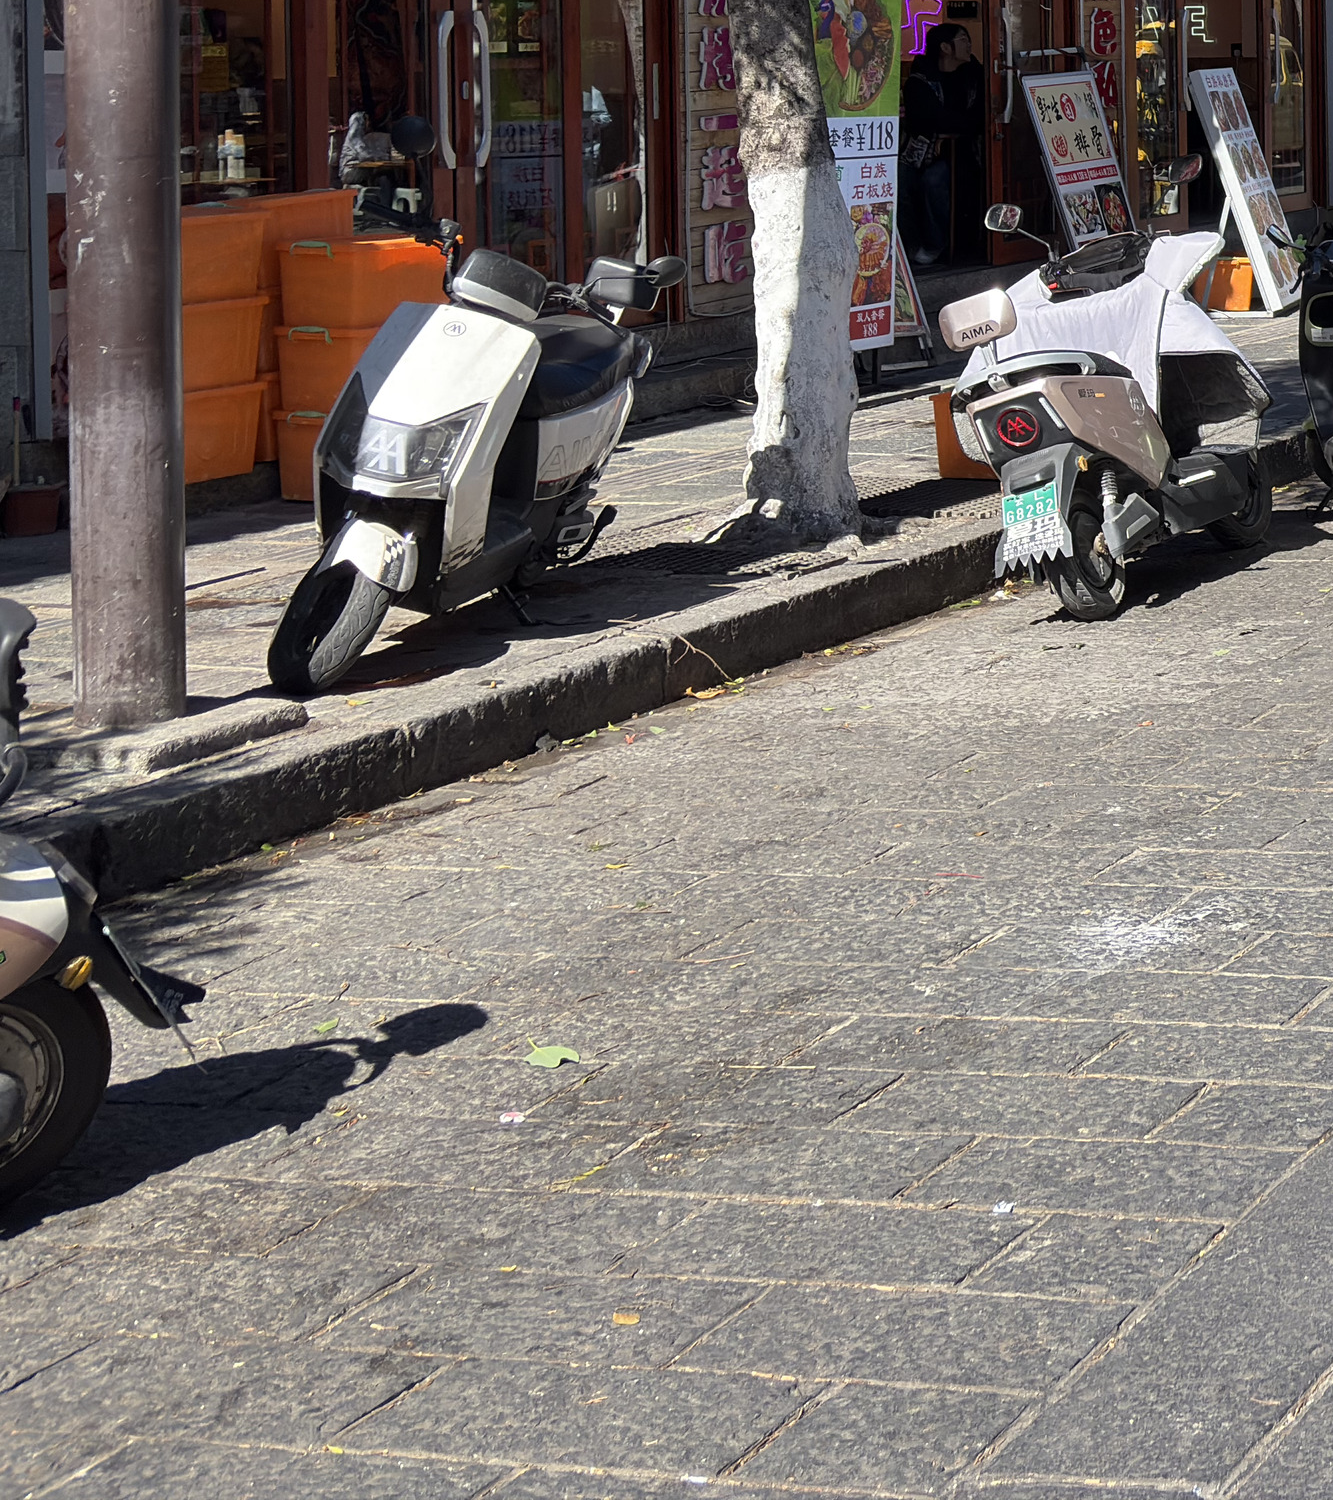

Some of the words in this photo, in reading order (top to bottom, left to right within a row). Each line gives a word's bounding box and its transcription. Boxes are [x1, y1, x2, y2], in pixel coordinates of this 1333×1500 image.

[861, 162, 887, 180] 白族
[852, 182, 894, 200] 石板烧
[961, 322, 994, 343] AIMA
